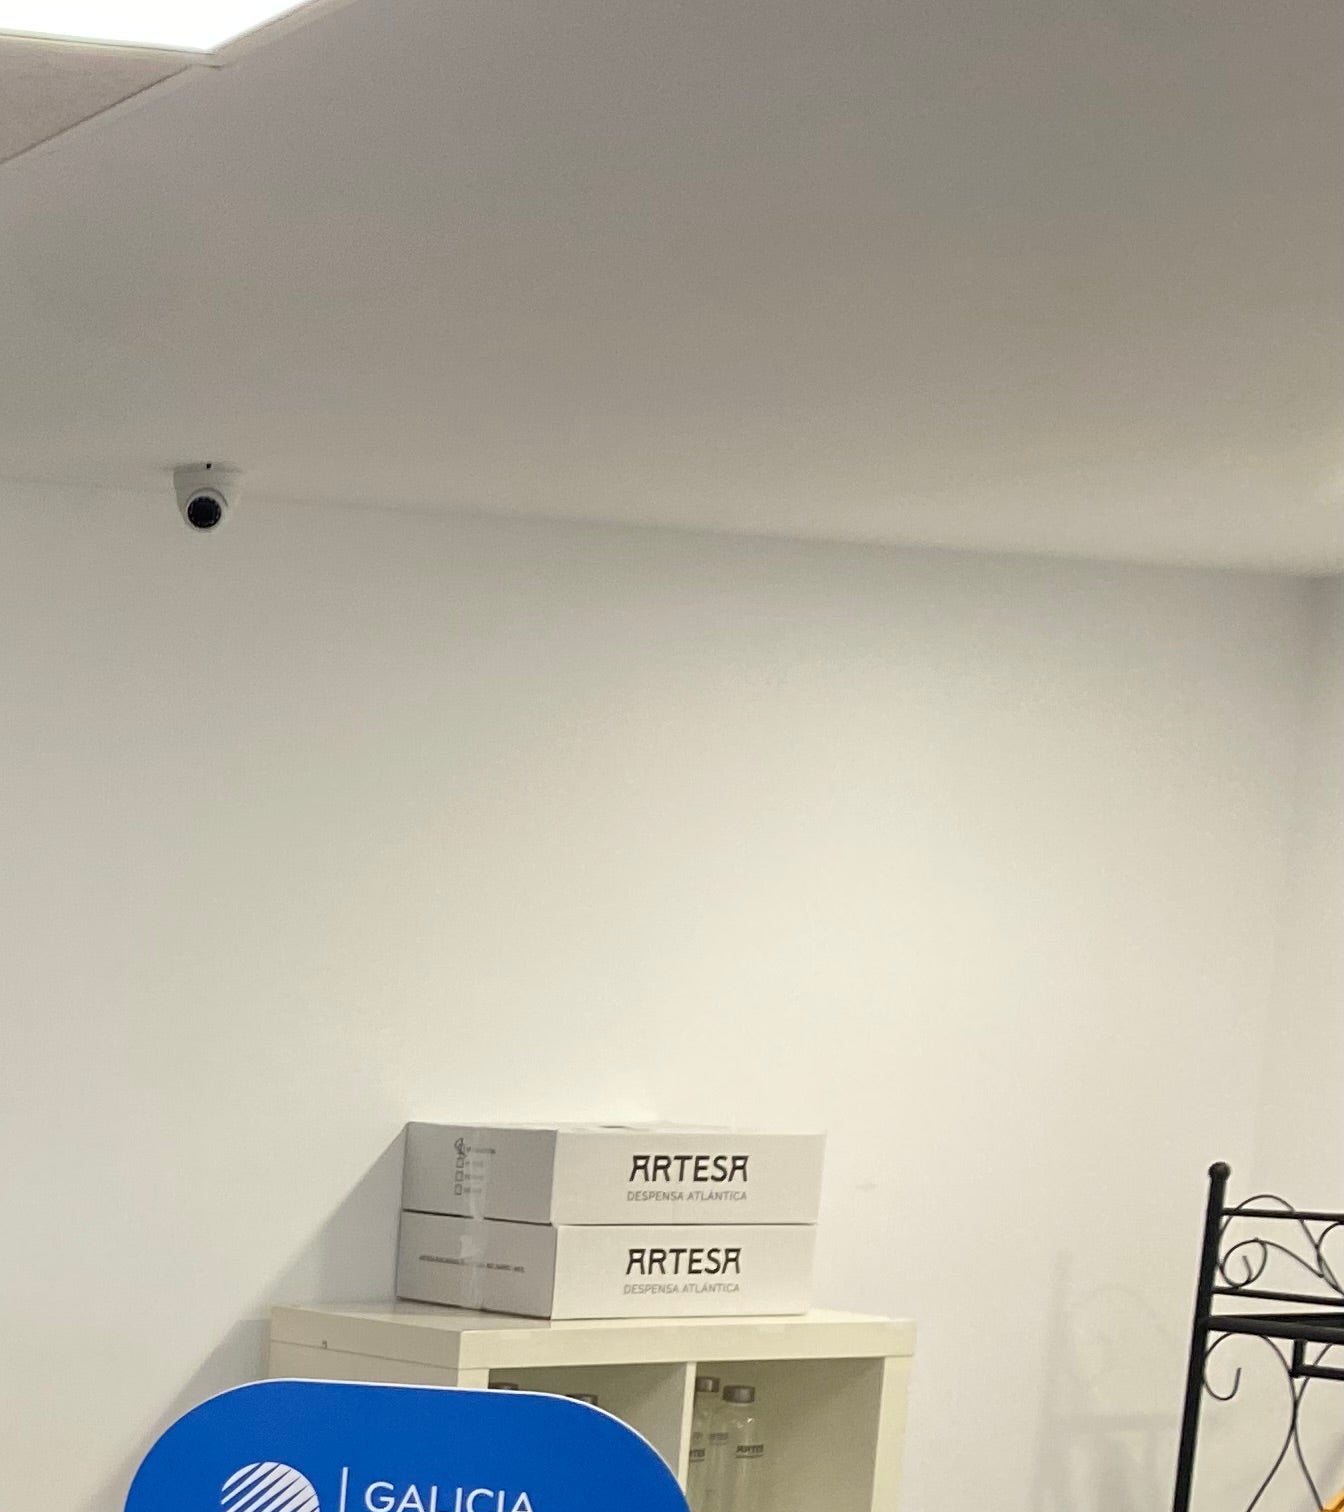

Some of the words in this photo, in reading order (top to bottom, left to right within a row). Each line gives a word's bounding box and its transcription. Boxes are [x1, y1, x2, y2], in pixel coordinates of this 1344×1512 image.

[628, 1154, 750, 1183] ARTESA
[627, 1190, 684, 1202] DESPENSA
[686, 1187, 748, 1202] ATLÁNTICA
[625, 1247, 743, 1276] ARTESA
[623, 1284, 679, 1295] DESPENSA
[681, 1281, 741, 1294] ATLÁNTICA
